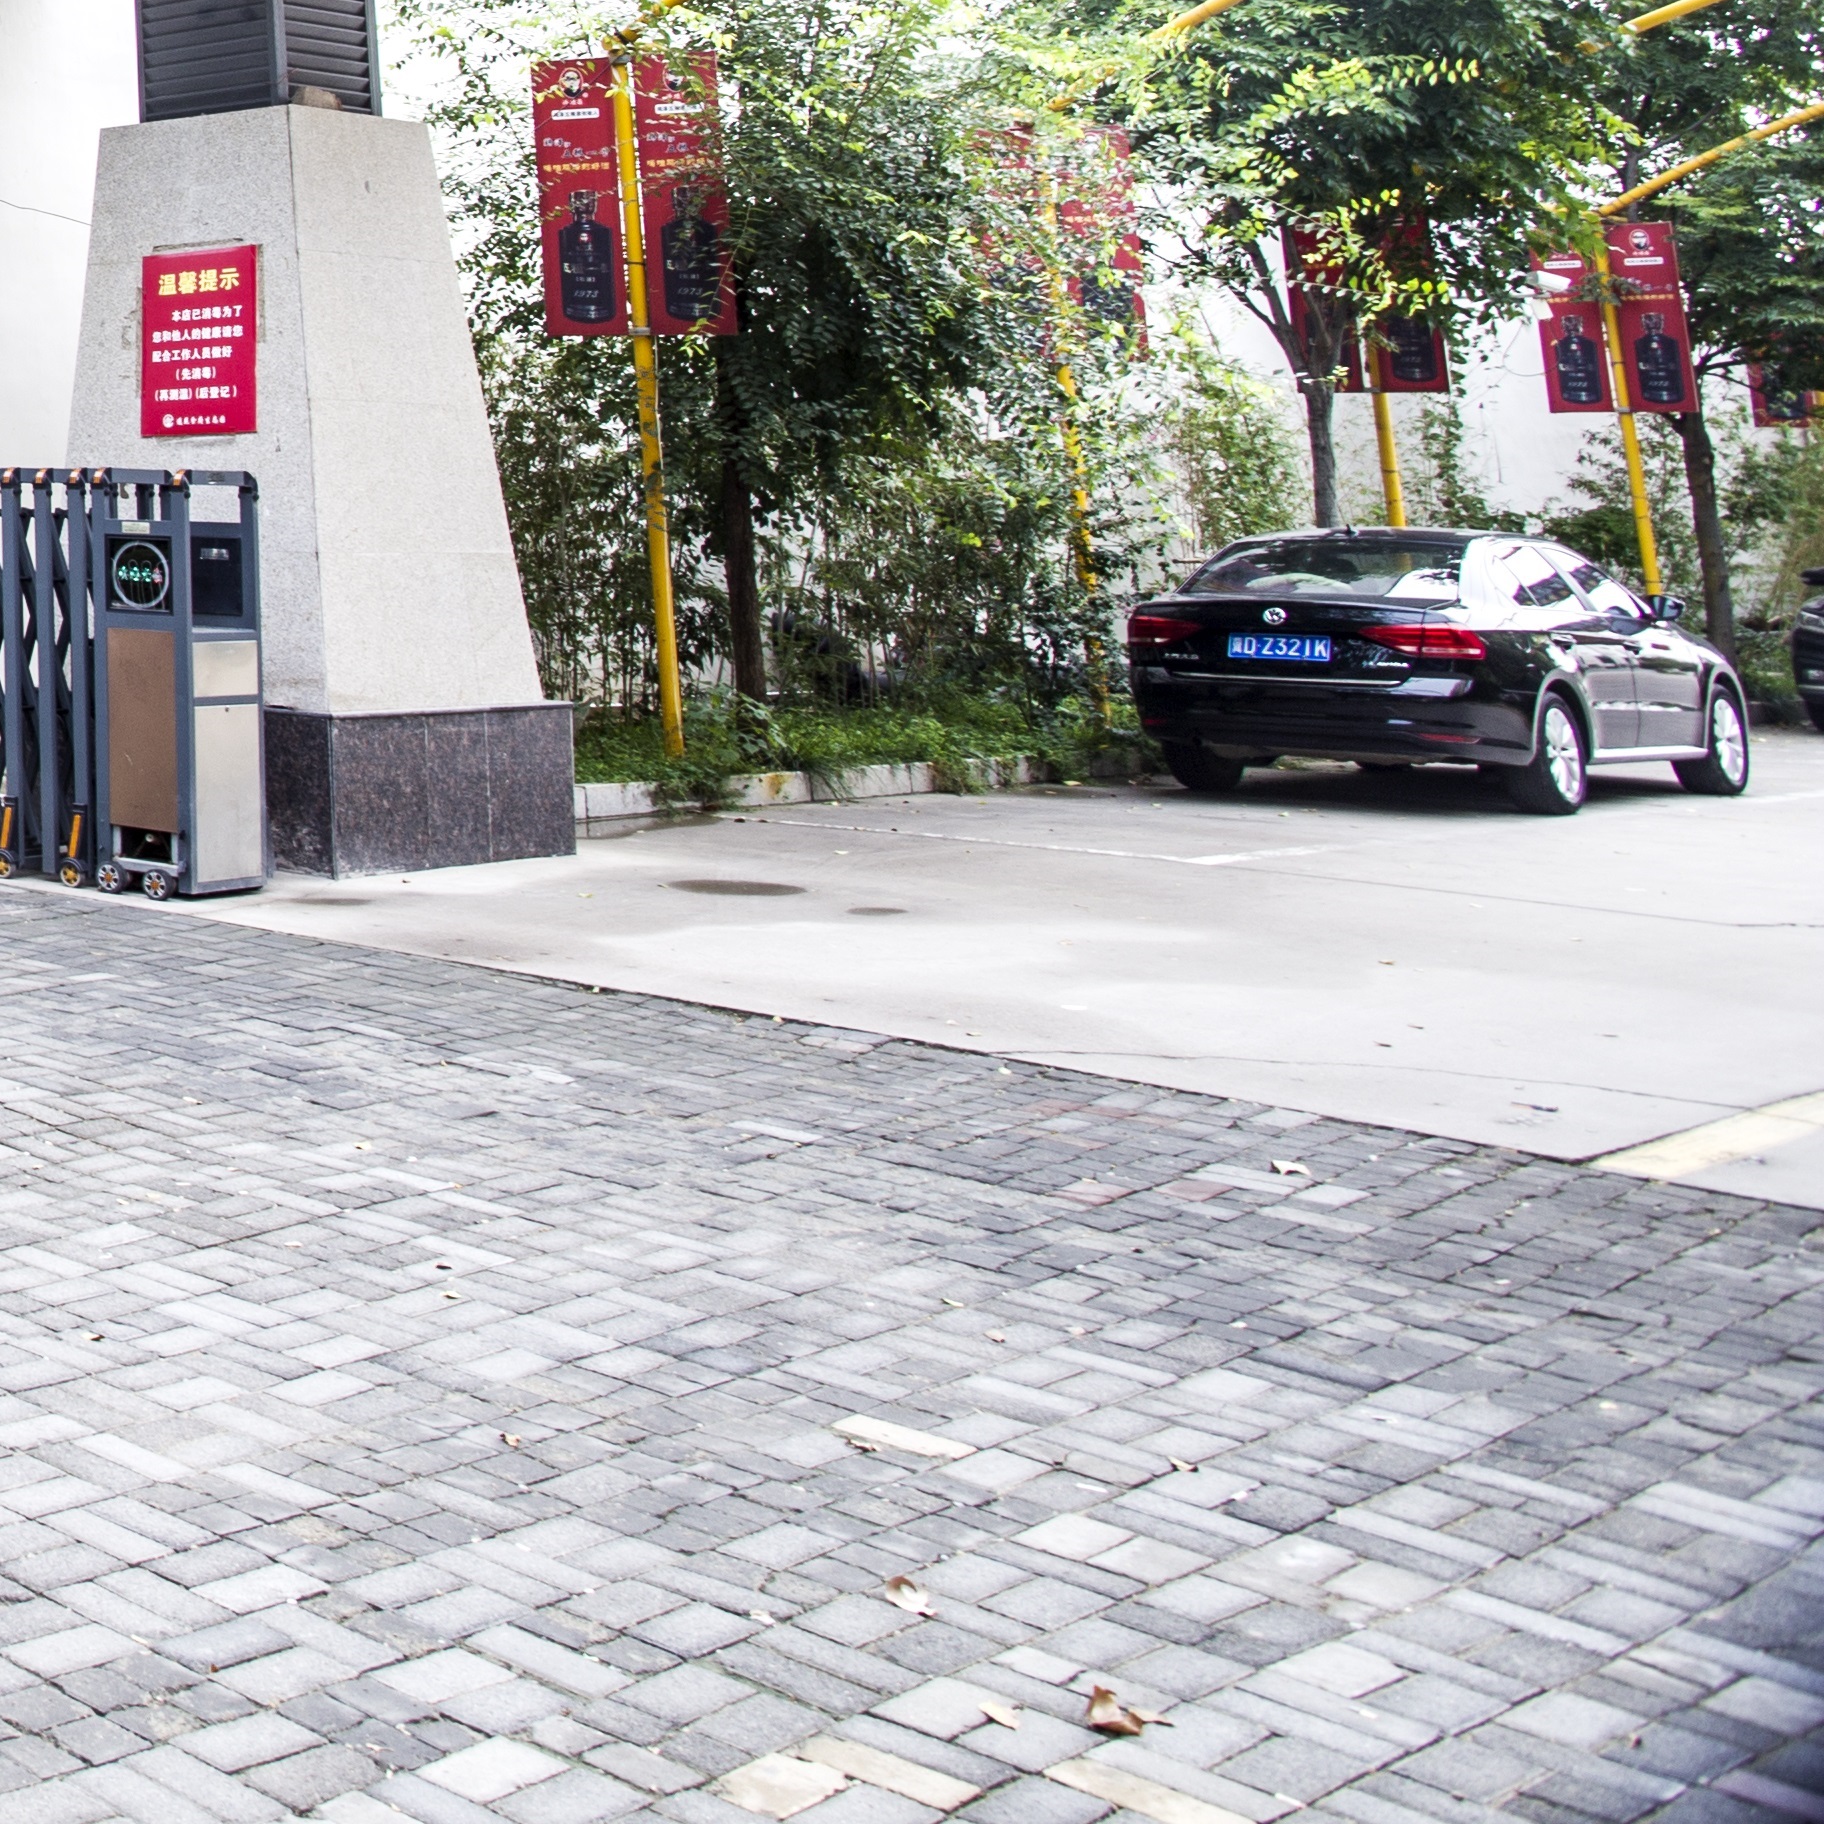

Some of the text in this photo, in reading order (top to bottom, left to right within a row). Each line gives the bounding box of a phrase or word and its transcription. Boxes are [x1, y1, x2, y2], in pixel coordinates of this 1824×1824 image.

[158, 267, 240, 296] 温馨提示
[171, 305, 243, 322] 本店已消毒为了
[152, 325, 244, 343] 您和他人的健康请您
[151, 345, 233, 363] 配合工作人员做好
